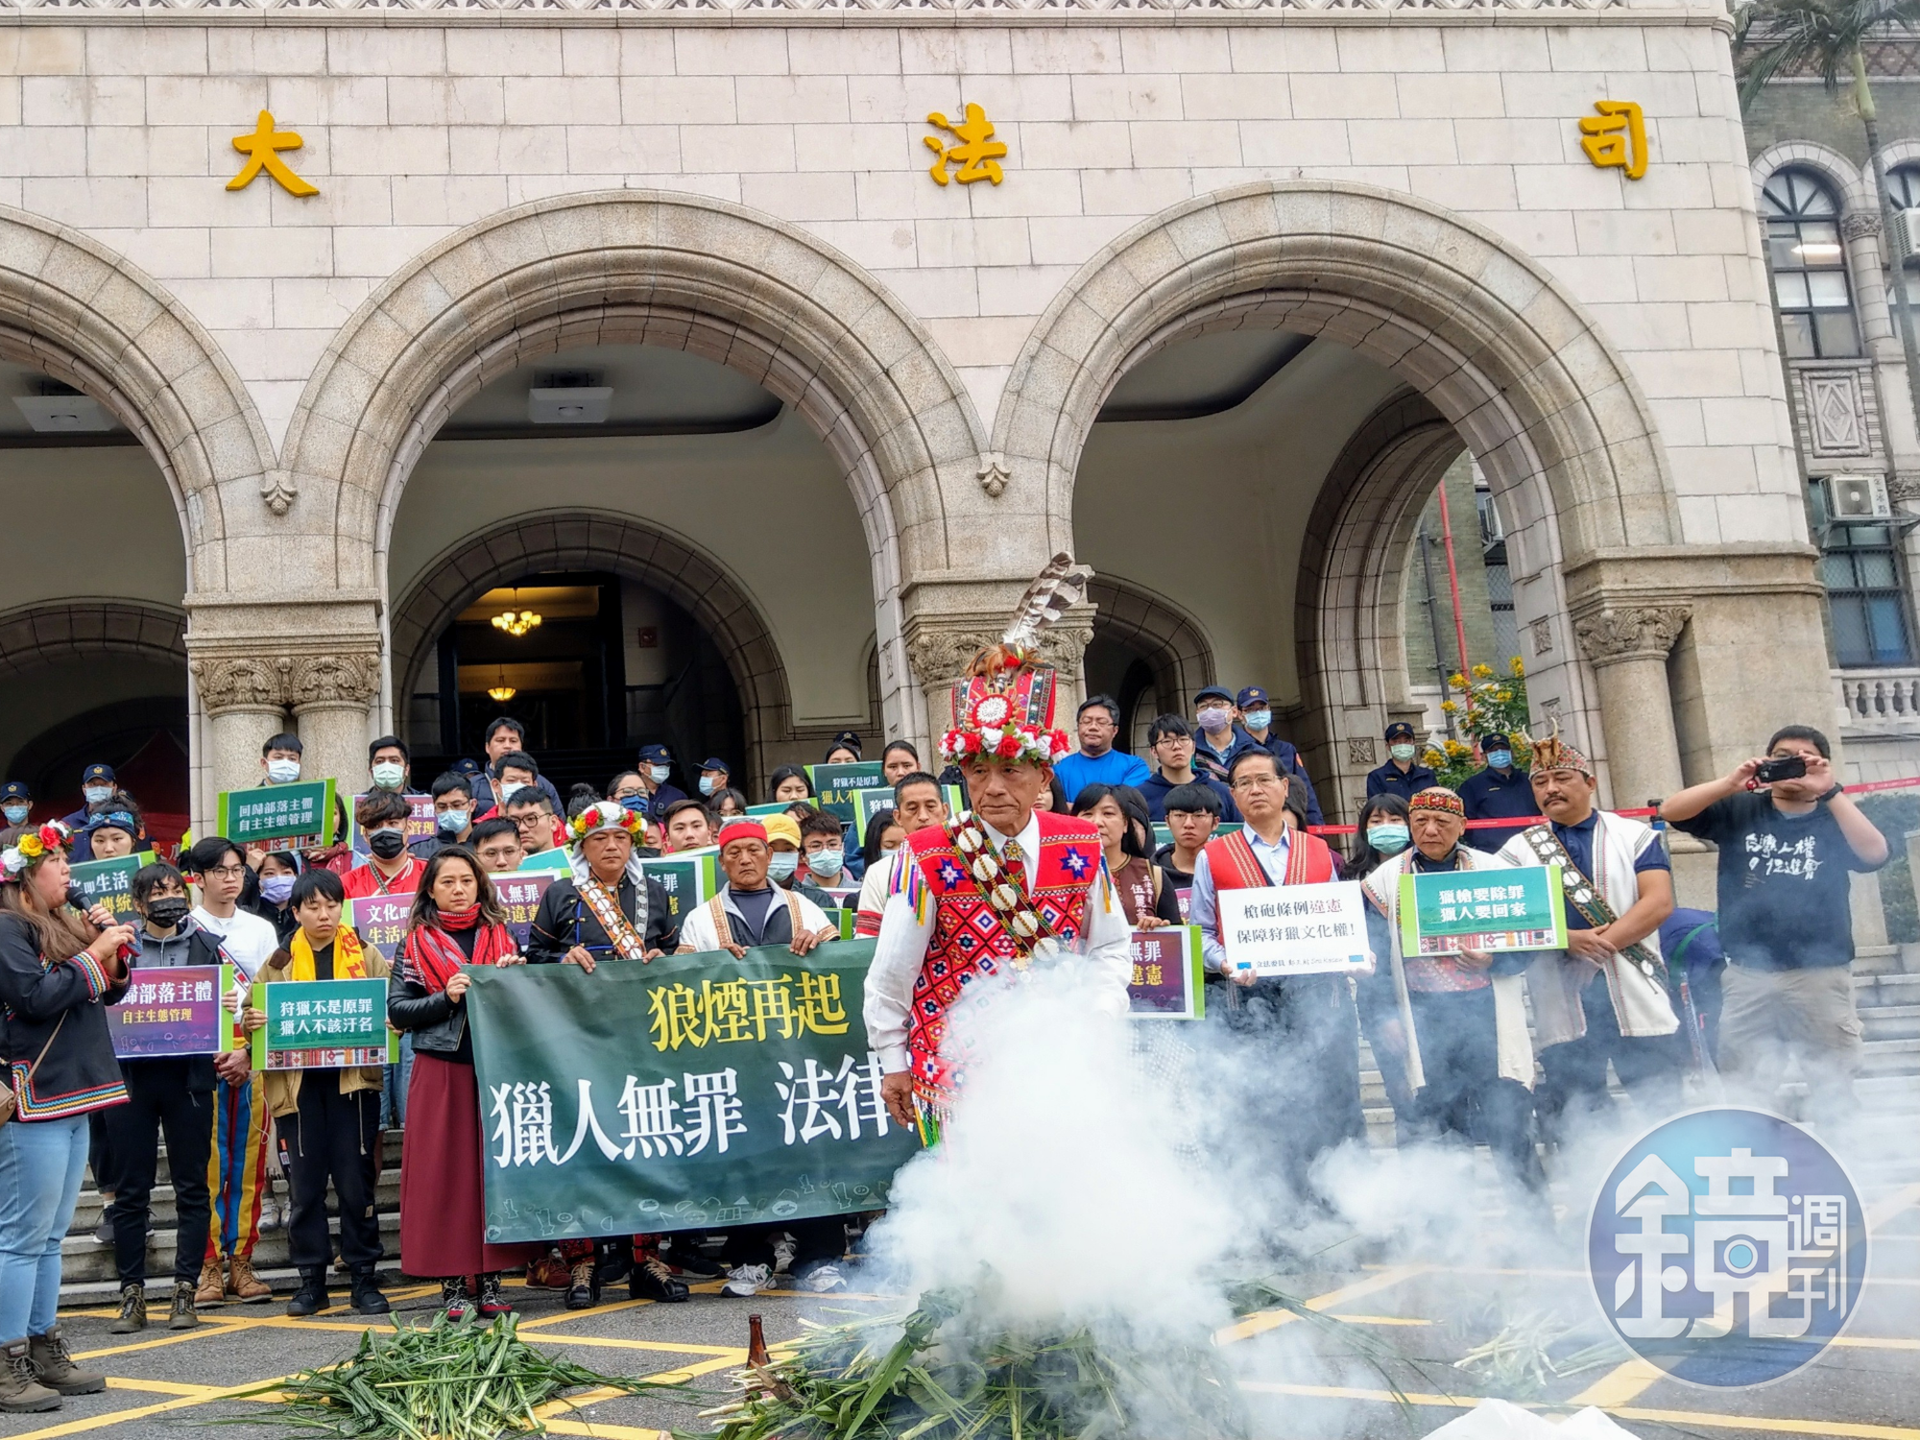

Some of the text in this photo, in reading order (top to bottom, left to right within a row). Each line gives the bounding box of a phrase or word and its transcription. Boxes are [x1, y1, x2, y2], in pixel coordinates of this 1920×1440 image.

[225, 100, 1649, 197] 大 法 司
[239, 797, 313, 818] 回歸部落主體
[239, 811, 313, 832] 自主生態管理
[1438, 885, 1526, 905] 獵槍要除罪
[1243, 898, 1343, 919] 槍砲條例違憲
[1440, 902, 1527, 922] 獵人要回家
[115, 980, 213, 1006] 歸部落主體
[123, 1008, 192, 1024] 自主生態管理
[280, 998, 373, 1017] 狩獵不是原罪
[647, 972, 850, 1052] 狼煙再起
[489, 1066, 748, 1169] 獵人無罪
